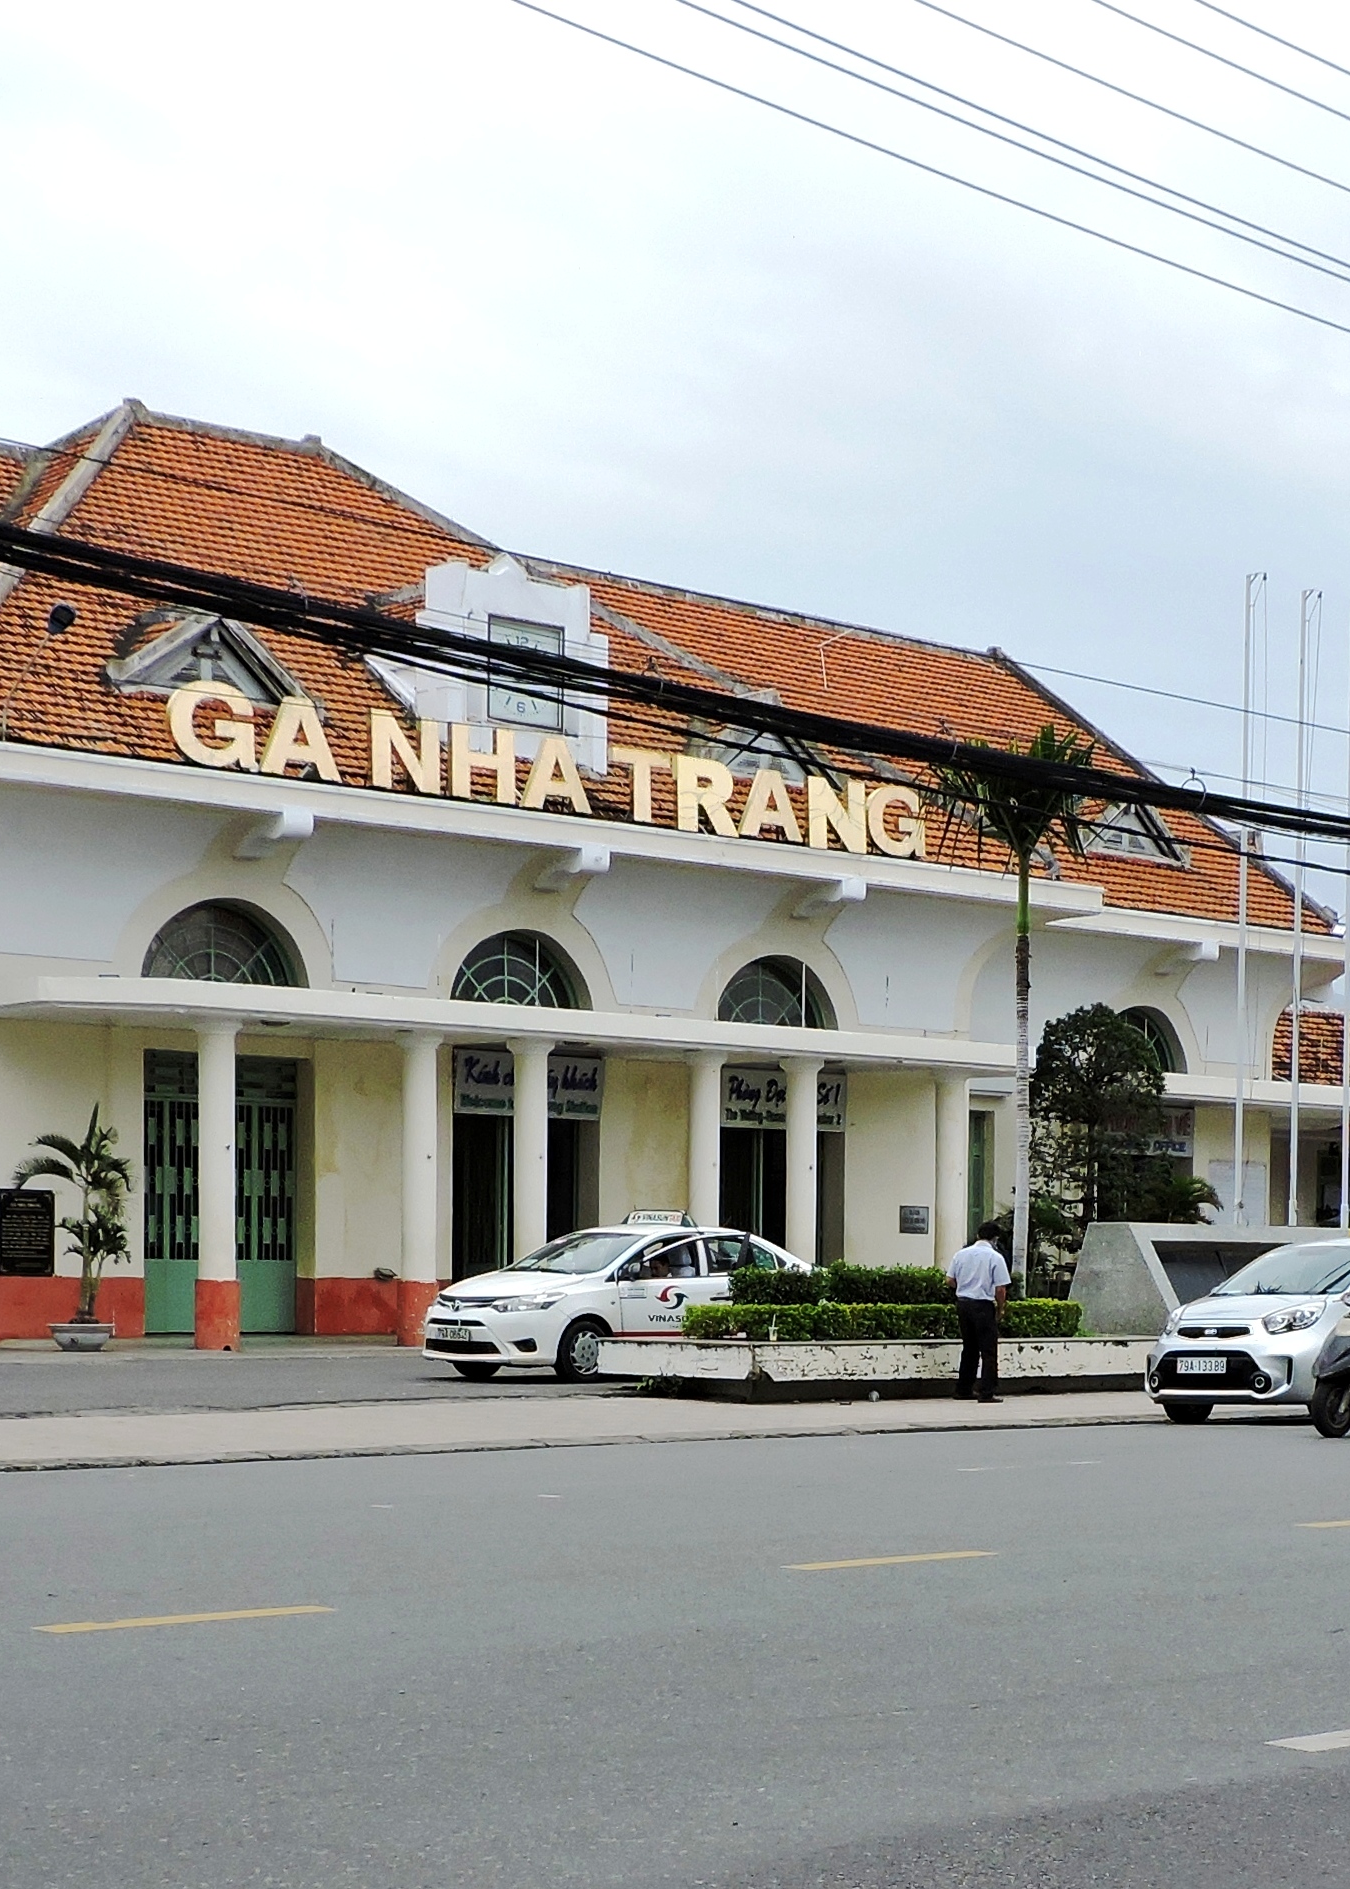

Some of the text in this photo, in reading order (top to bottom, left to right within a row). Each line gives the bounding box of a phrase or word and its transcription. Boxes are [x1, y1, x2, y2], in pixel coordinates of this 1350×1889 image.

[166, 680, 926, 857] GA NHA TRANG
[647, 1314, 690, 1323] VINASU
